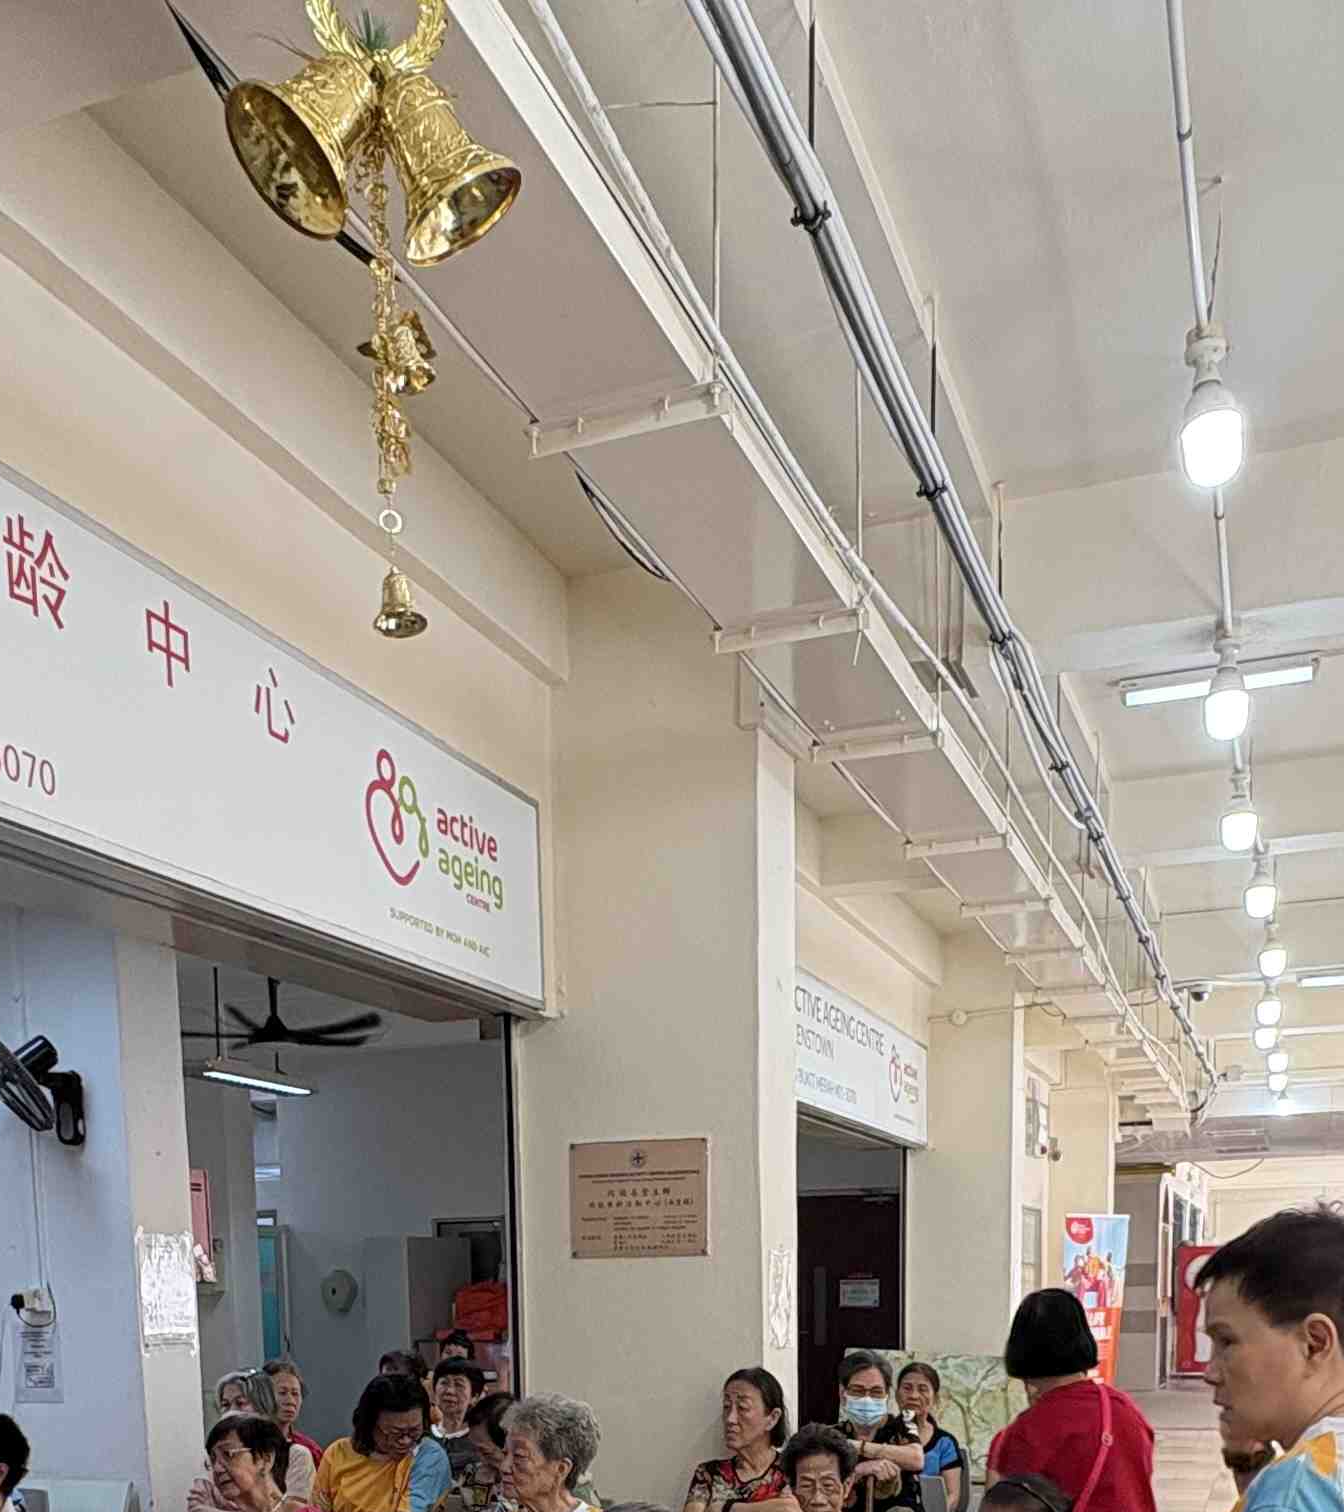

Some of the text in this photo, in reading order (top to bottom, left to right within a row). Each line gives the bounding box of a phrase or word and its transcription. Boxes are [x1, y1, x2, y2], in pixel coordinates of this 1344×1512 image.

[436, 807, 498, 863] active
[438, 847, 504, 911] ageing
[794, 985, 822, 1024] CTIVE
[796, 1023, 835, 1061] ENSTOWN
